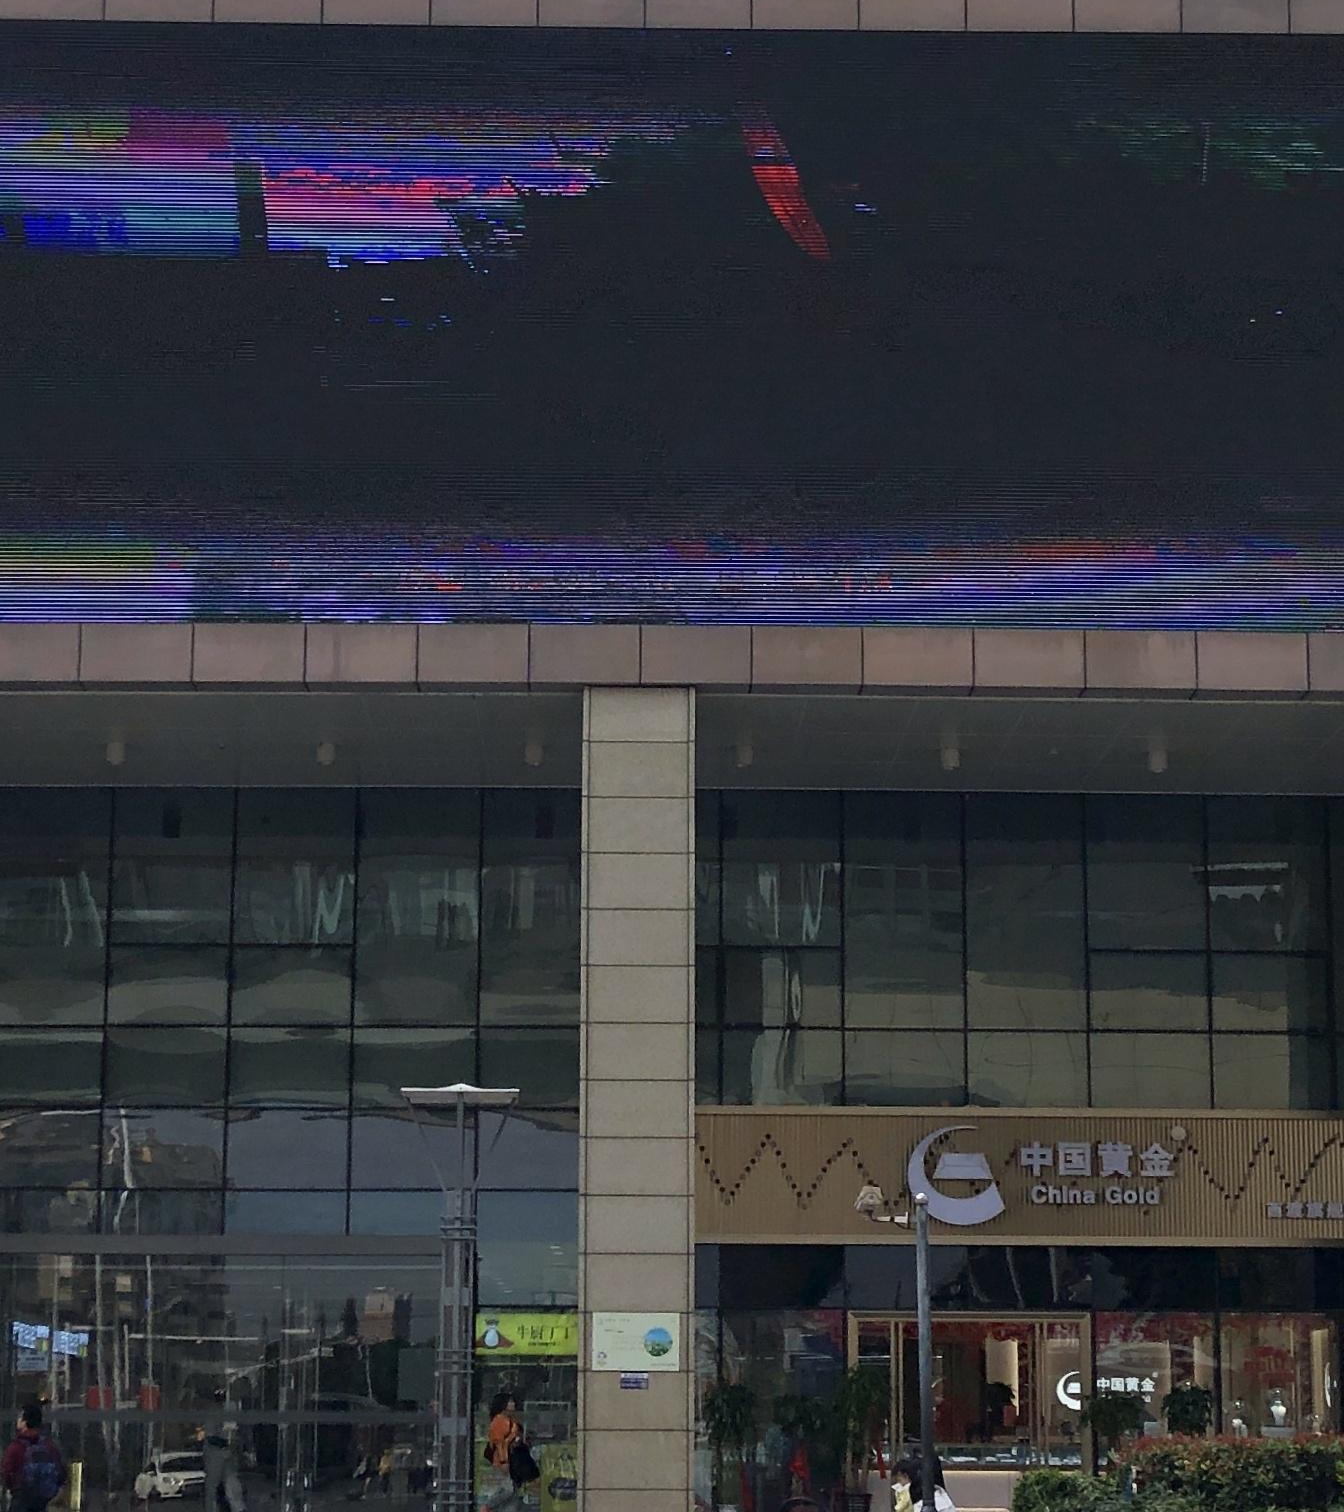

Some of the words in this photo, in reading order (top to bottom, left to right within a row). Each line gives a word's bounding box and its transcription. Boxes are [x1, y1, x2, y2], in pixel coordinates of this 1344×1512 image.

[1020, 1141, 1175, 1177] 中国黄金
[1030, 1184, 1096, 1206] China
[1106, 1184, 1161, 1206] Gold
[1096, 1376, 1156, 1393] 中国黄金
